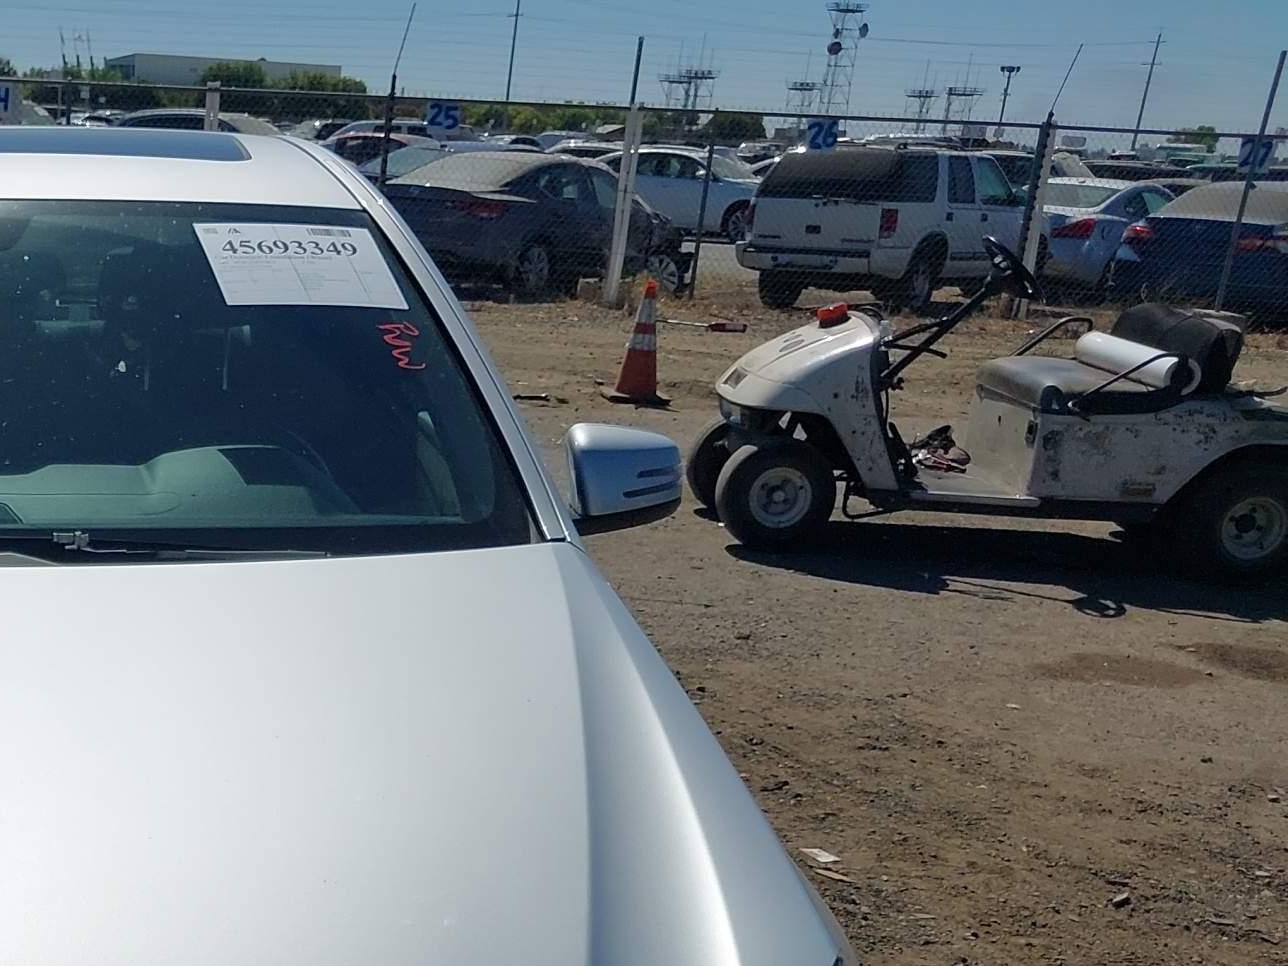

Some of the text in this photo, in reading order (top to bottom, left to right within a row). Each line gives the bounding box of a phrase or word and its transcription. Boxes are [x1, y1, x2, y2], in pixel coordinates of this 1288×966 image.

[429, 103, 459, 129] 25
[807, 119, 839, 149] 26
[1240, 138, 1273, 168] 27
[222, 239, 358, 257] 45693349
